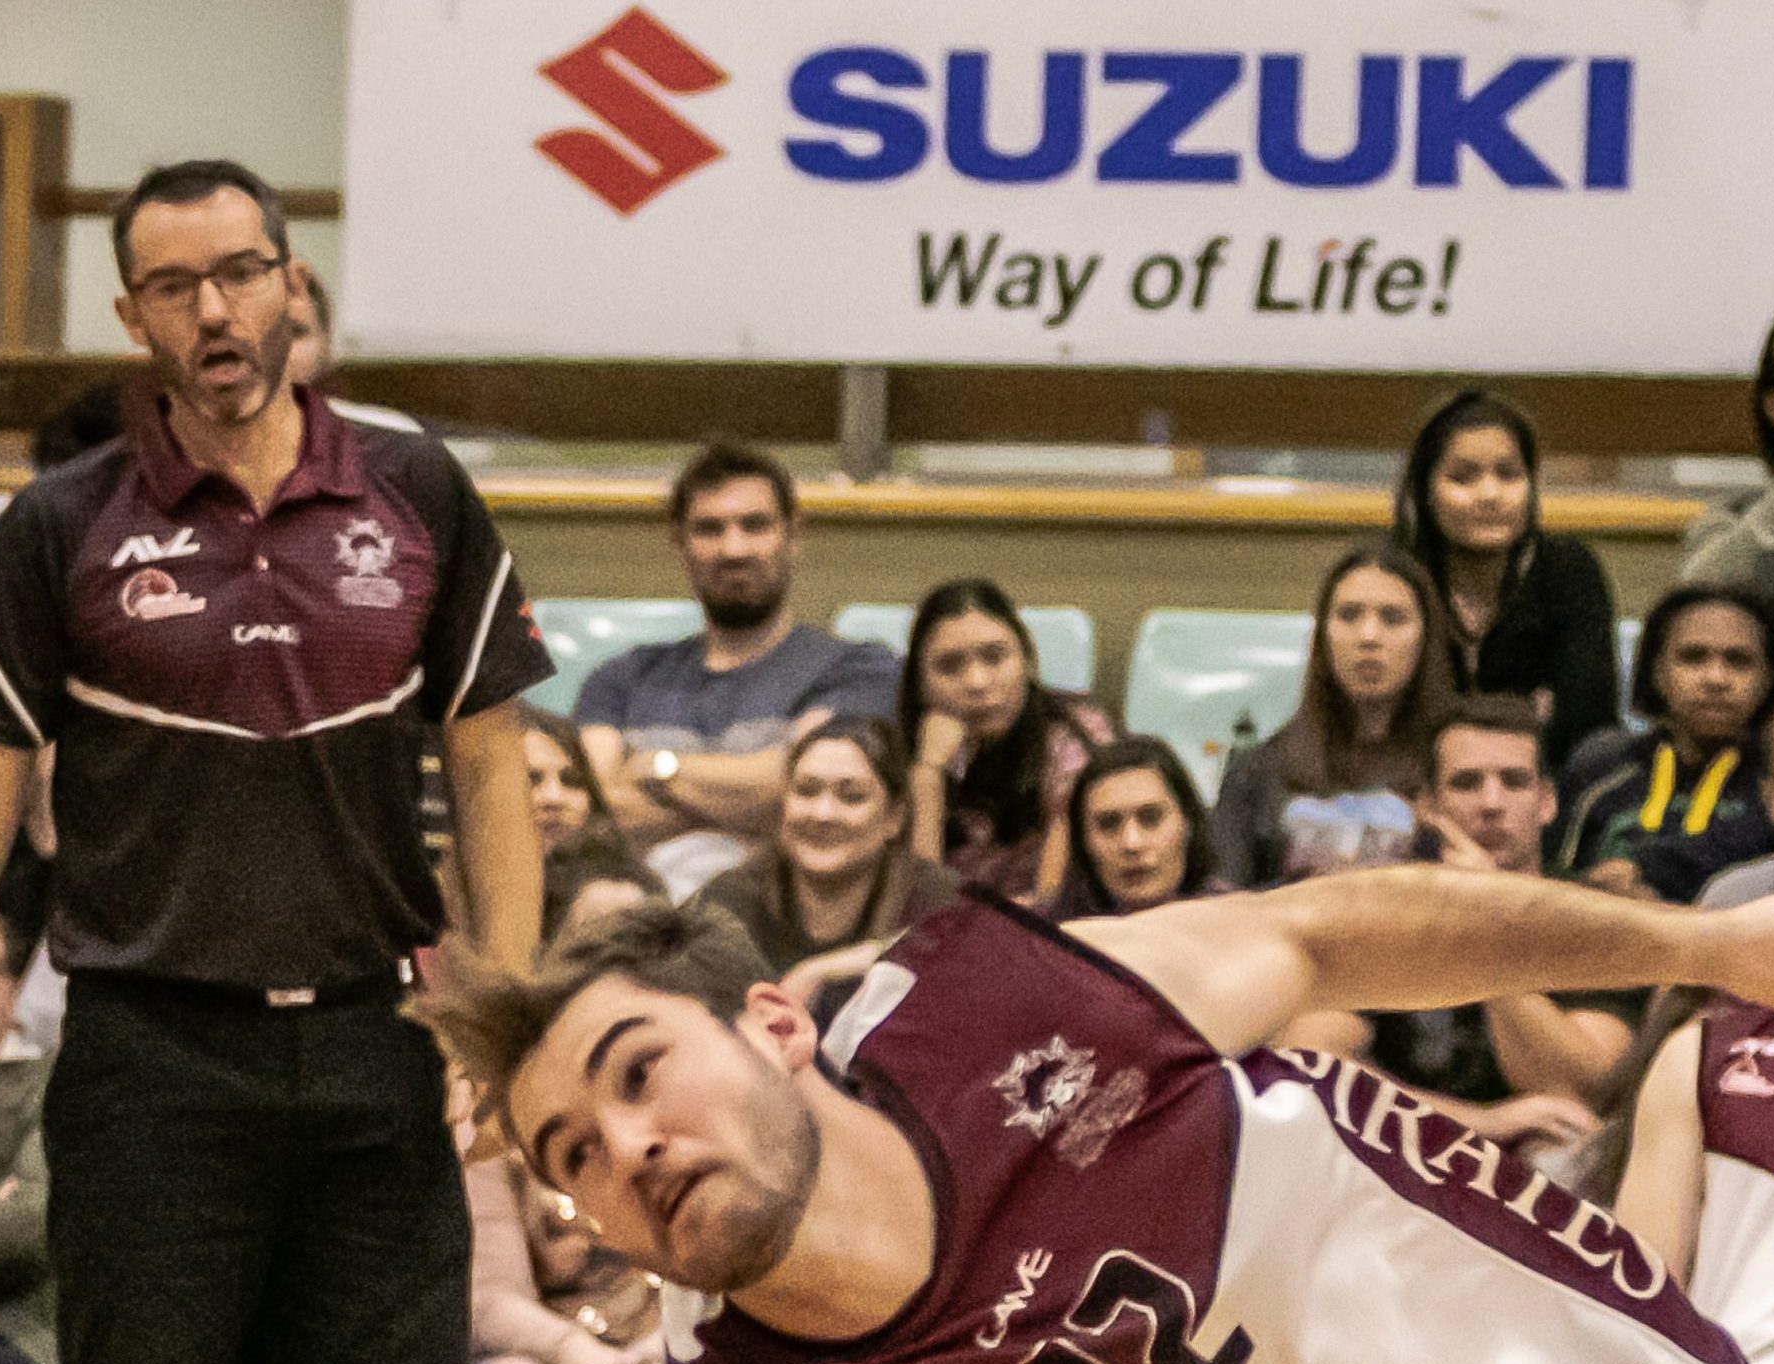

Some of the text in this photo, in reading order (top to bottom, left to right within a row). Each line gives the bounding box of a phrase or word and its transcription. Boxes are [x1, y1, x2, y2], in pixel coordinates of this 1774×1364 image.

[783, 45, 1635, 191] SUZUKI
[916, 231, 1462, 329] Way of Life!
